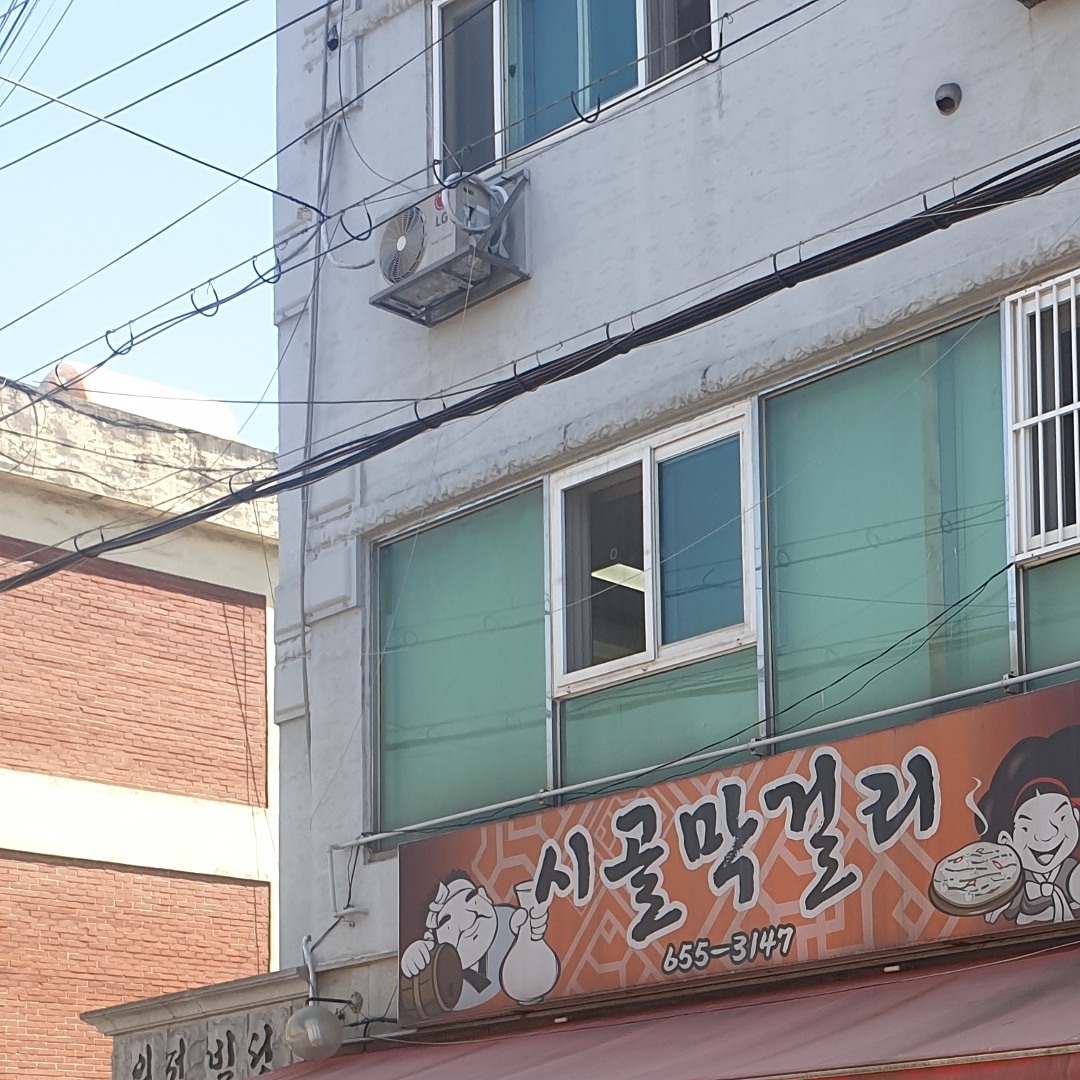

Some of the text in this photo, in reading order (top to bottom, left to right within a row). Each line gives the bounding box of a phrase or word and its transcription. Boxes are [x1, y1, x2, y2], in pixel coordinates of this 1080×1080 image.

[435, 210, 449, 227] LG
[533, 748, 940, 946] 시골막걸리
[661, 924, 797, 974] 655-3147
